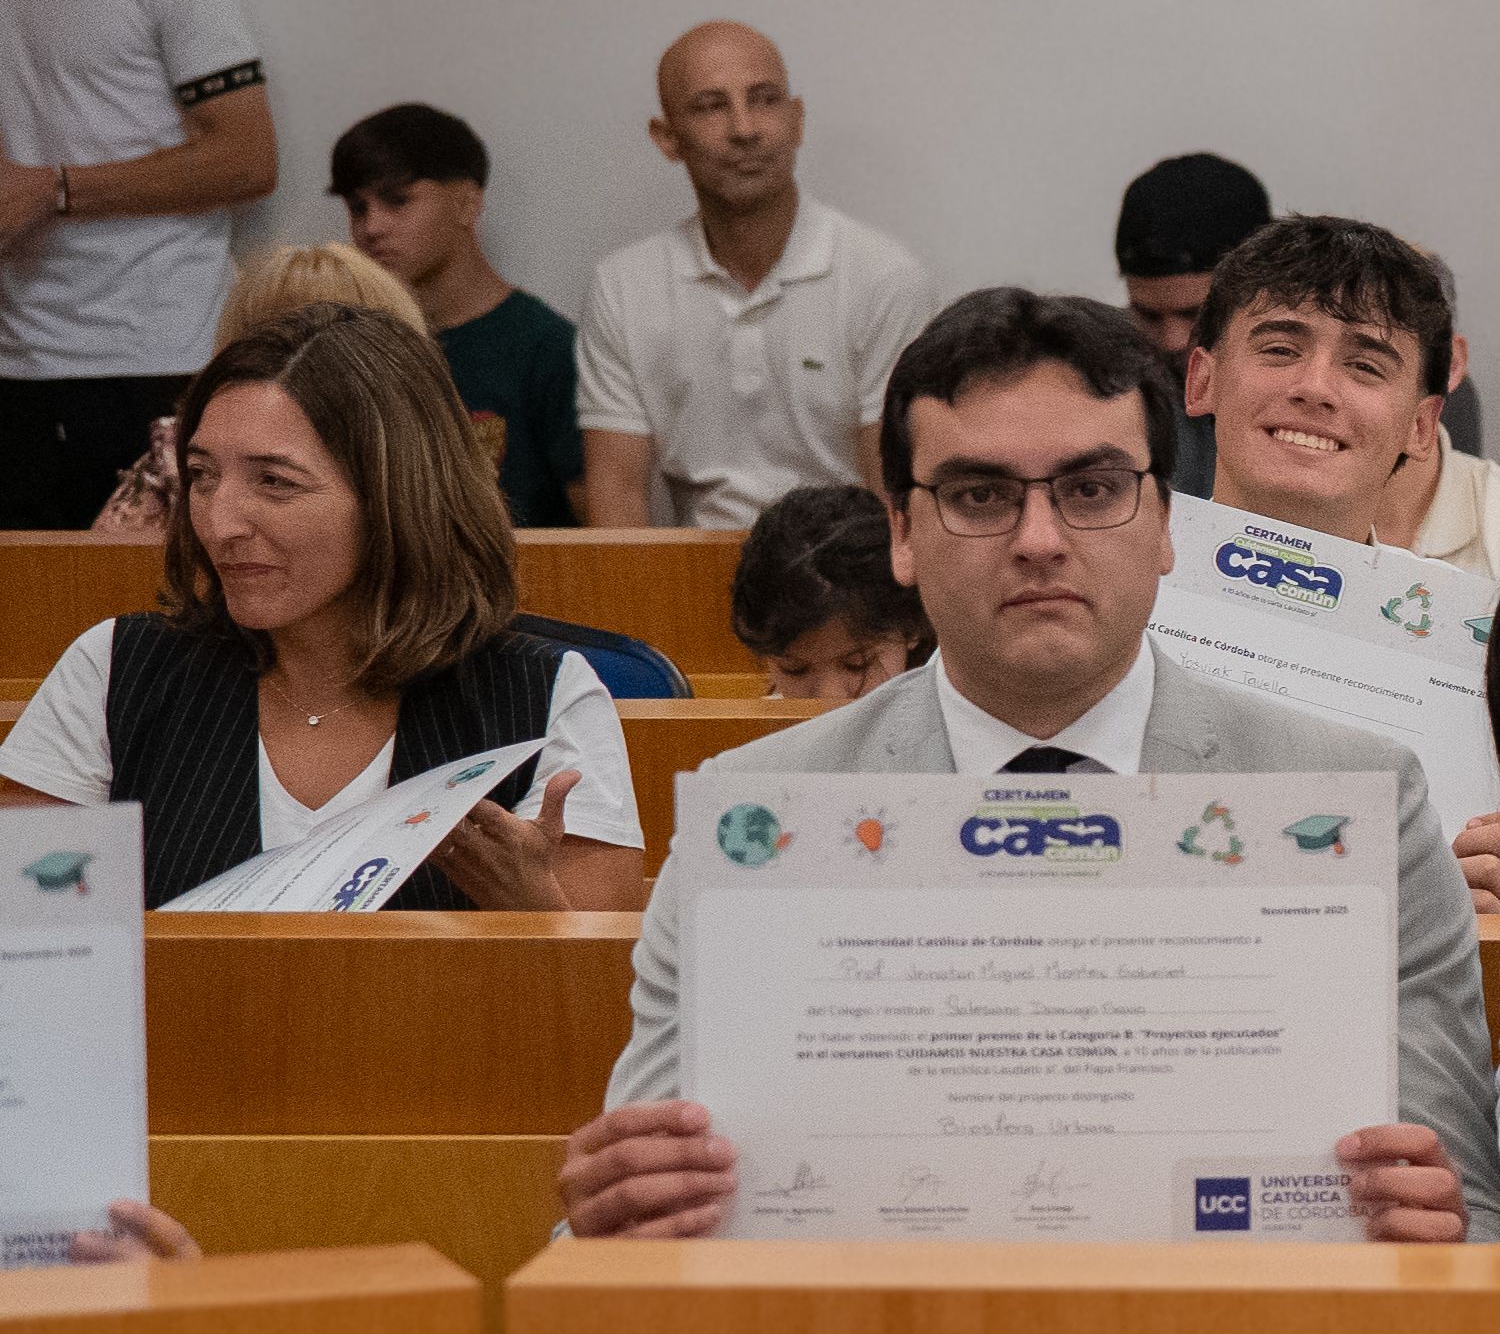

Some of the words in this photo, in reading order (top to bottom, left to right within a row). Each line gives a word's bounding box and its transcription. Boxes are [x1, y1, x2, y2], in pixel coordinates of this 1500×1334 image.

[1244, 524, 1313, 551] CERTAMEN
[1216, 541, 1344, 598] casa
[1276, 582, 1335, 609] común
[1157, 623, 1198, 643] Católica
[1199, 635, 1213, 647] de
[1213, 639, 1256, 659] Córdoba
[1256, 653, 1289, 669] otorga
[1289, 662, 1300, 671] el
[1299, 665, 1342, 684] presente
[1342, 677, 1415, 704] reconocimiento
[1417, 698, 1423, 706] a
[1429, 676, 1477, 696] Noviembre
[983, 788, 1070, 800] CERTAMEN
[959, 814, 1121, 856] casa
[1261, 1174, 1352, 1188] UNIVERSID
[1199, 1194, 1246, 1214] UCC
